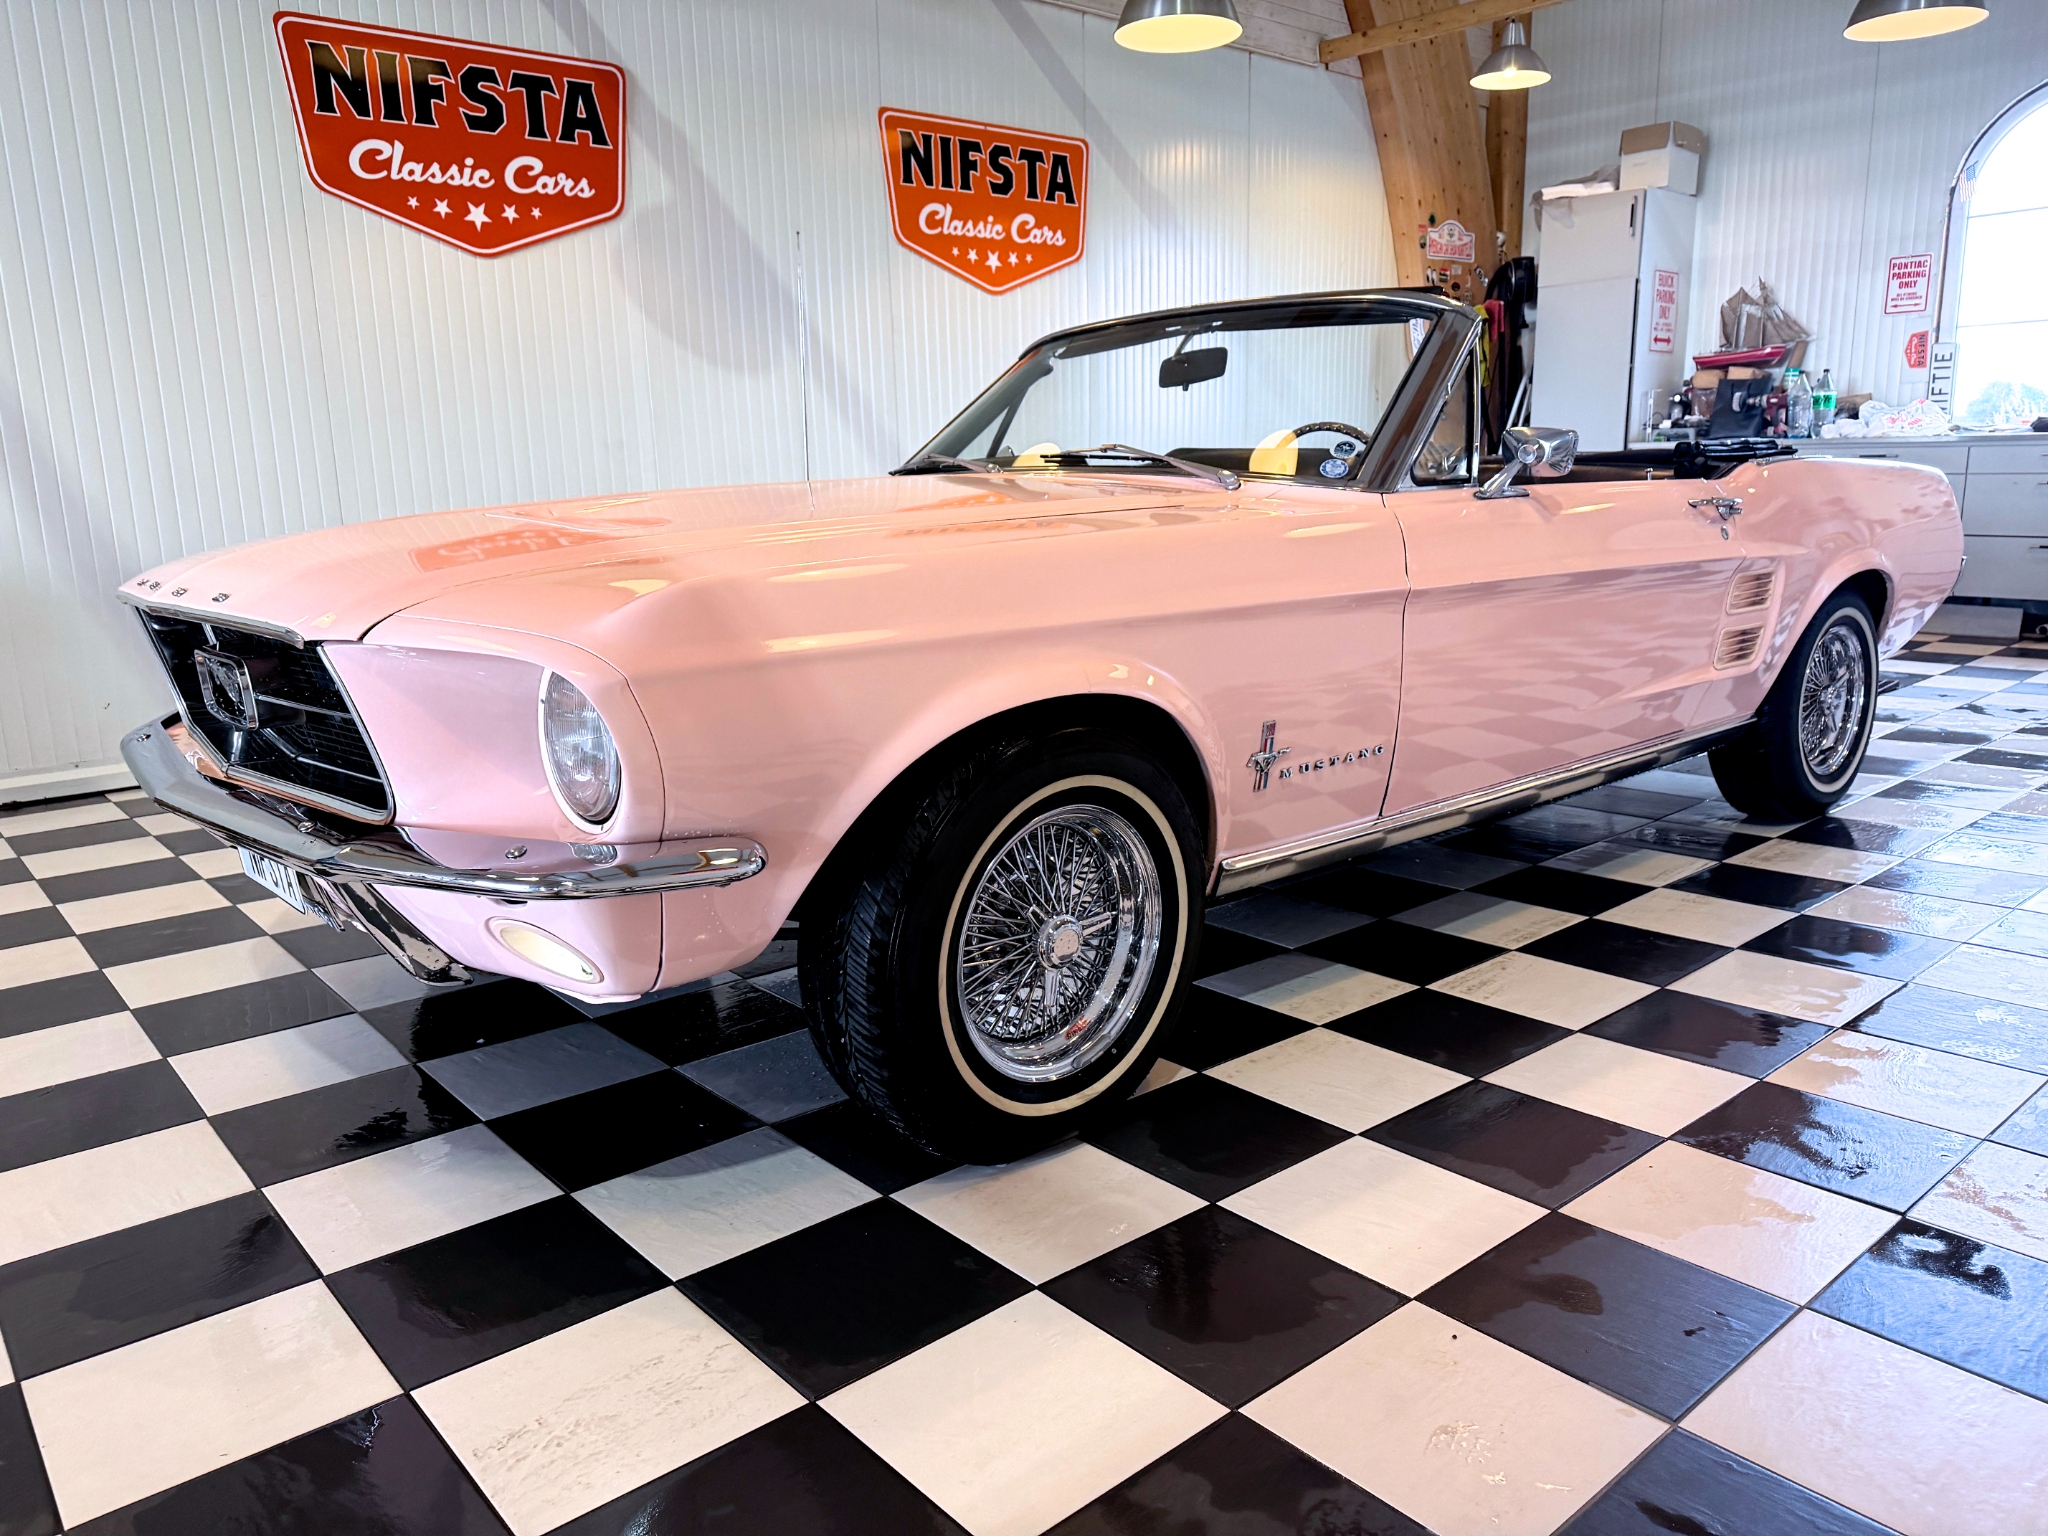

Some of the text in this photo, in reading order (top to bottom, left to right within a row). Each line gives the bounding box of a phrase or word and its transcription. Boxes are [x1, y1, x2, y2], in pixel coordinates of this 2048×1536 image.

[304, 38, 613, 149] NIFSTA
[348, 138, 596, 198] Classic Cars
[897, 127, 1078, 206] NIFSTA
[918, 202, 1066, 246] Classic Cars
[1892, 259, 1928, 271] PONTIAC
[1892, 270, 1927, 281] PARKING
[1658, 274, 1674, 288] BUICK
[1898, 279, 1918, 289] ONLY
[1656, 288, 1675, 304] PARKING
[1659, 305, 1670, 319] ONLY
[1917, 334, 1926, 366] NIFSTA
[1278, 744, 1385, 779] MUSTANG
